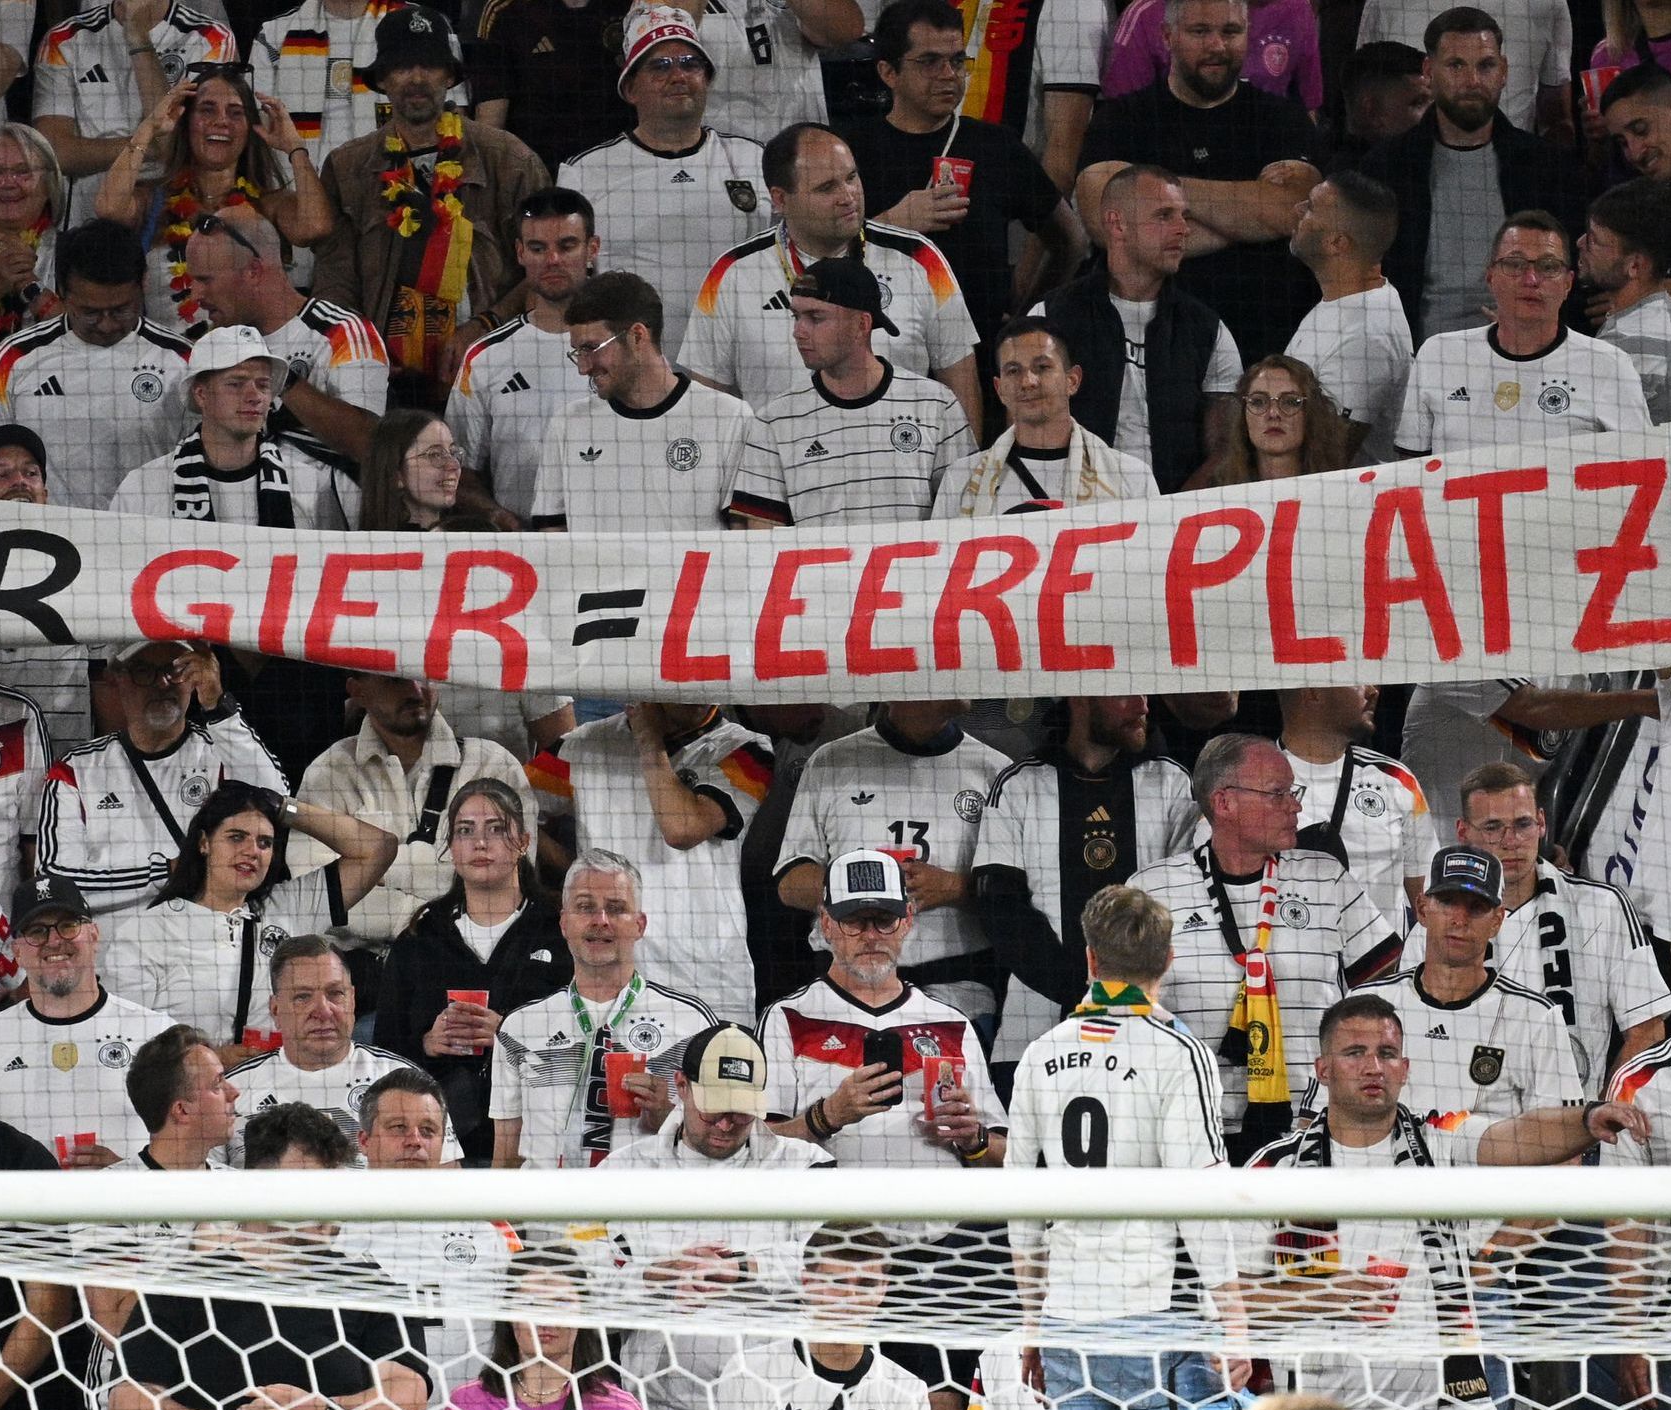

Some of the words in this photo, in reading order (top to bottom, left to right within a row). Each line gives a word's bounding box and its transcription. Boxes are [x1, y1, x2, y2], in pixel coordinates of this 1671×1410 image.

[131, 550, 538, 691] GIER
[573, 590, 645, 646] =
[661, 523, 1136, 682] LEERE
[887, 820, 931, 865] 13
[1044, 1051, 1092, 1077] BIER
